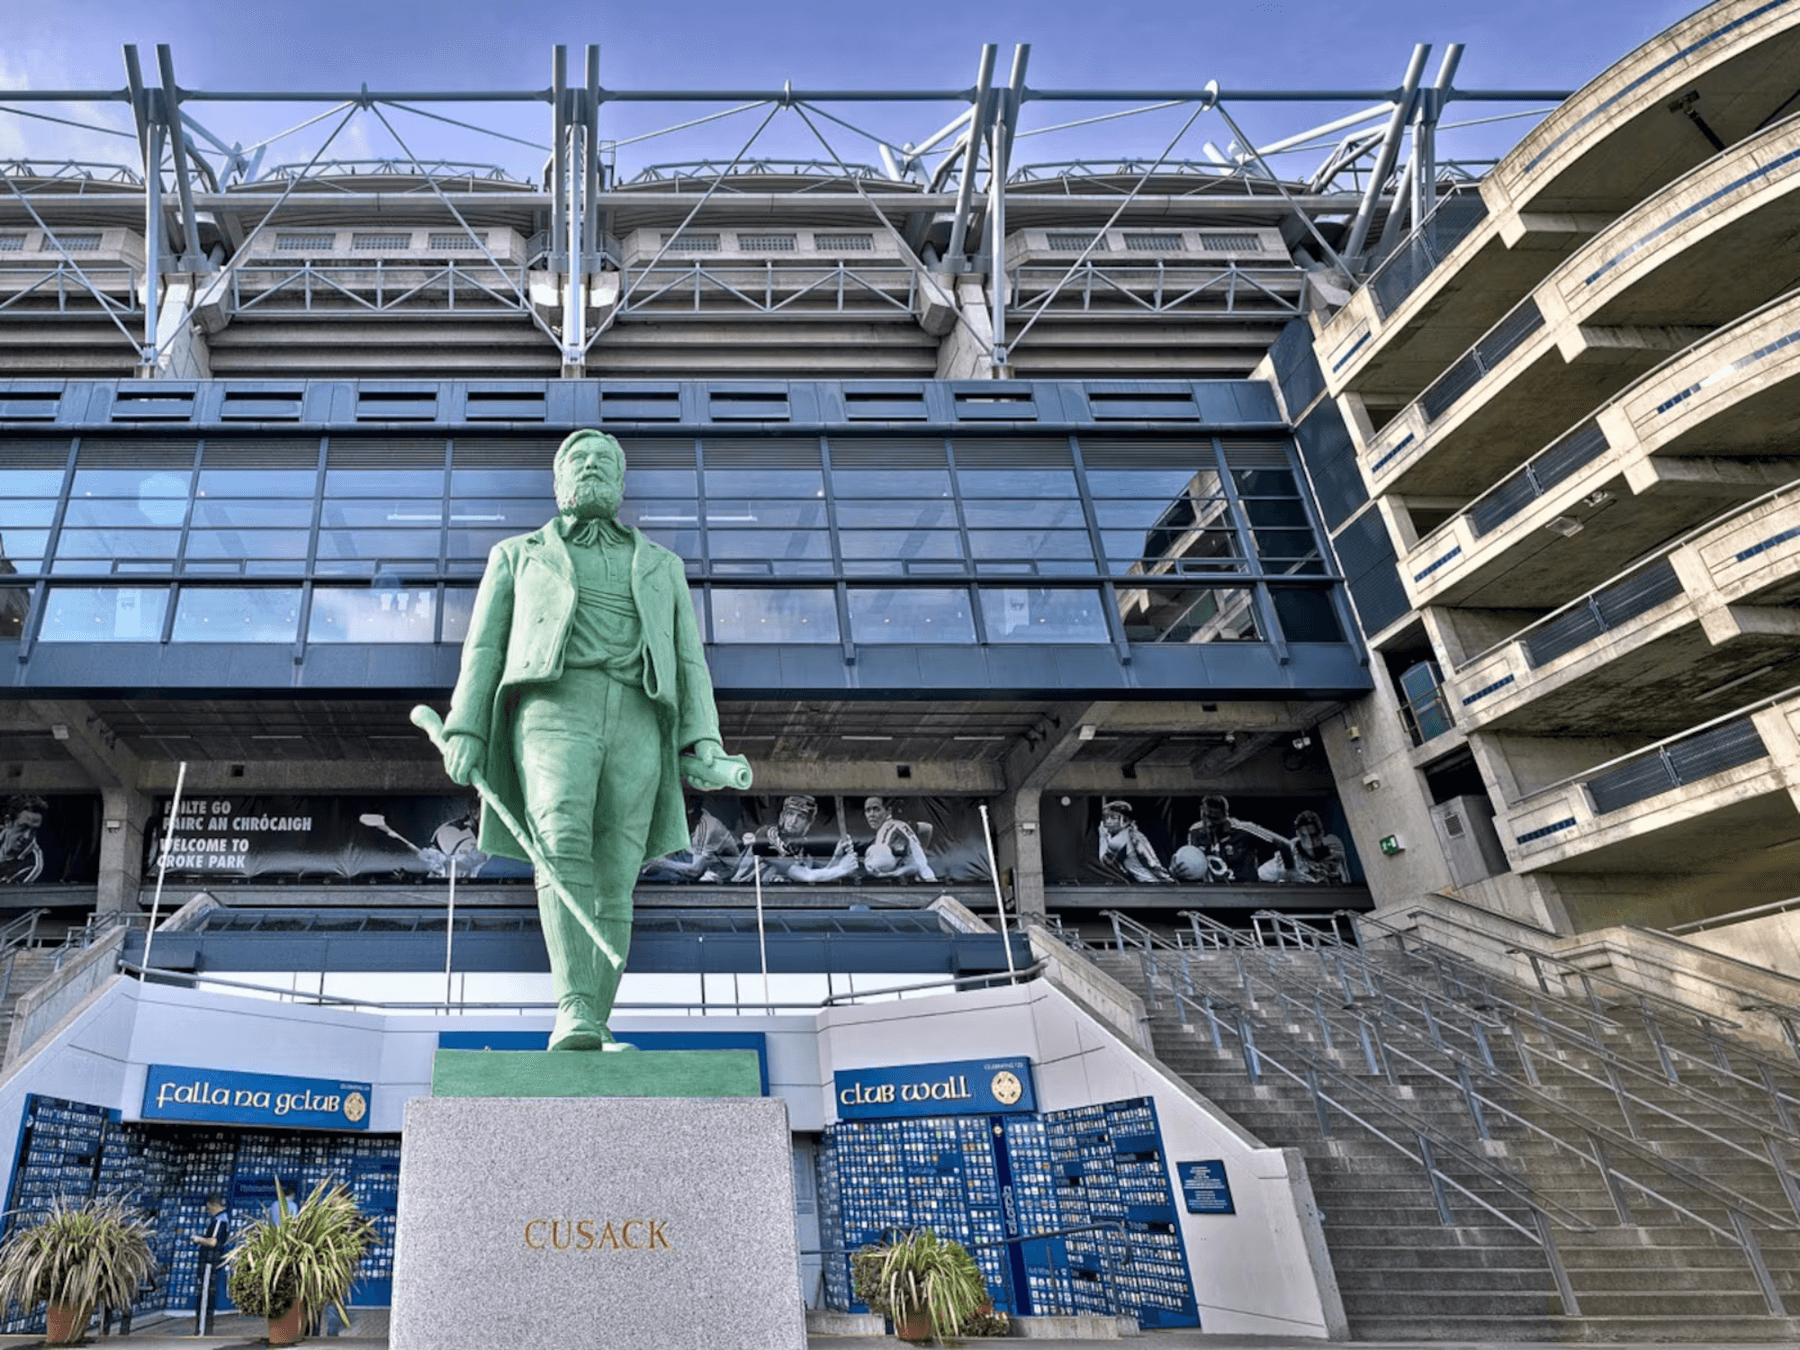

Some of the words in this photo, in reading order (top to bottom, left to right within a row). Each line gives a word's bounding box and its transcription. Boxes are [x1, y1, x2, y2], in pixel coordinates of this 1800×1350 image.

[211, 801, 232, 815] GO
[207, 816, 228, 831] AN
[232, 813, 312, 831] CHRÓCAIGH
[159, 837, 228, 852] WELCOME
[232, 838, 249, 852] TO
[156, 854, 204, 868] CROKE
[207, 854, 246, 868] PARK
[524, 1218, 672, 1251] CUSACK
